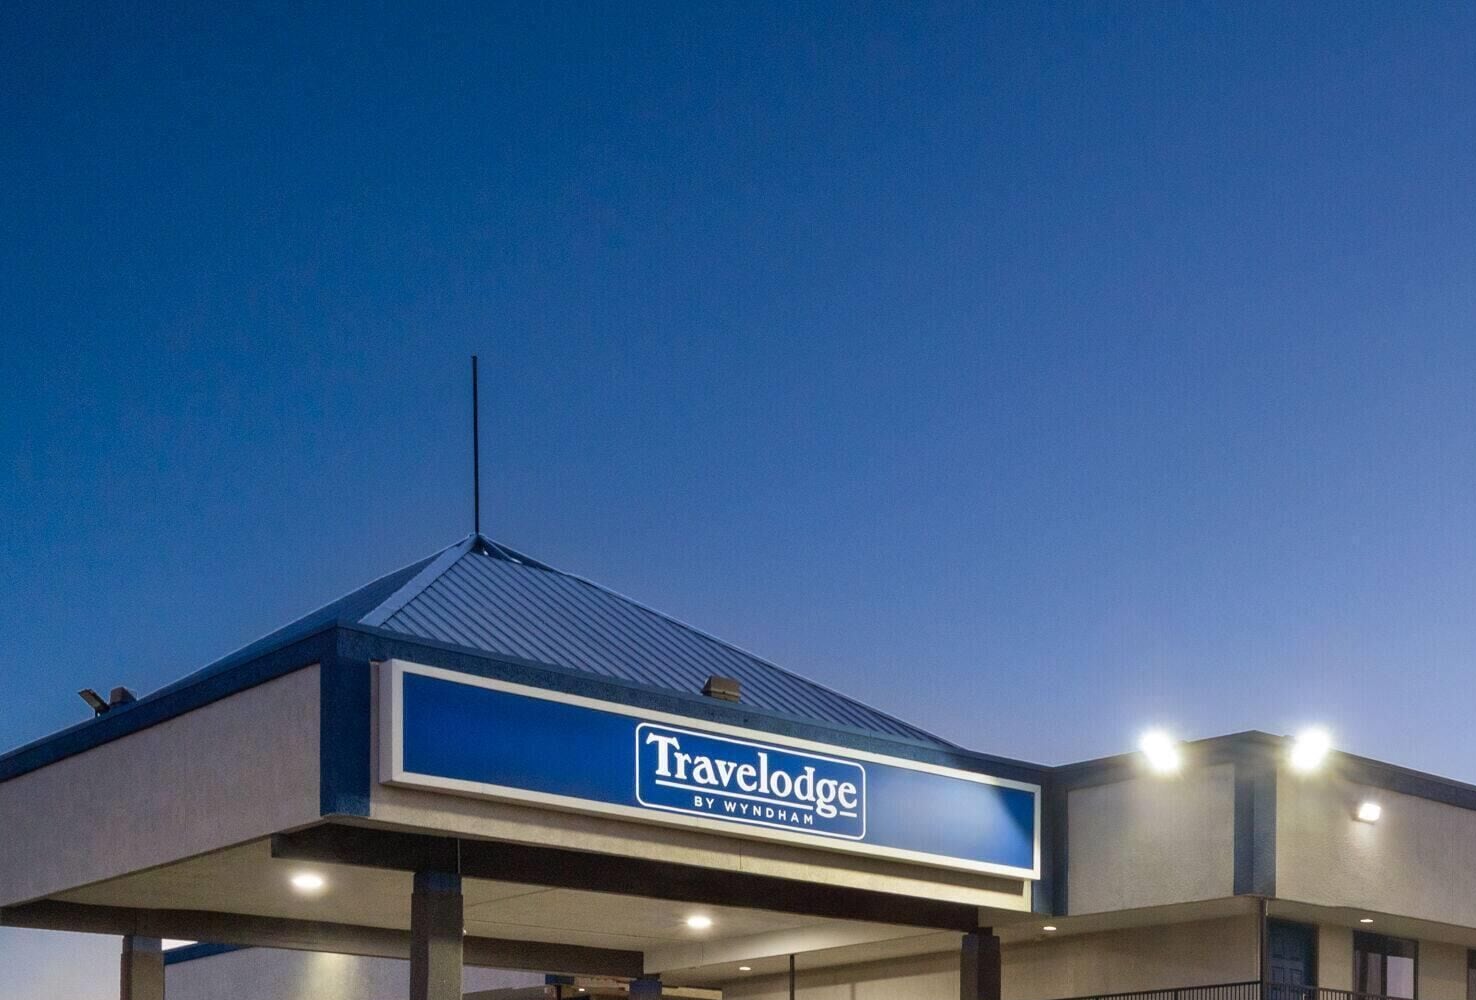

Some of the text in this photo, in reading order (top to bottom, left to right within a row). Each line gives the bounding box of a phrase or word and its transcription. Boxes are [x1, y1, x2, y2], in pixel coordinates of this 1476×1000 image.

[646, 732, 857, 818] Travelodge
[694, 796, 813, 825] BY WYNDHAM
